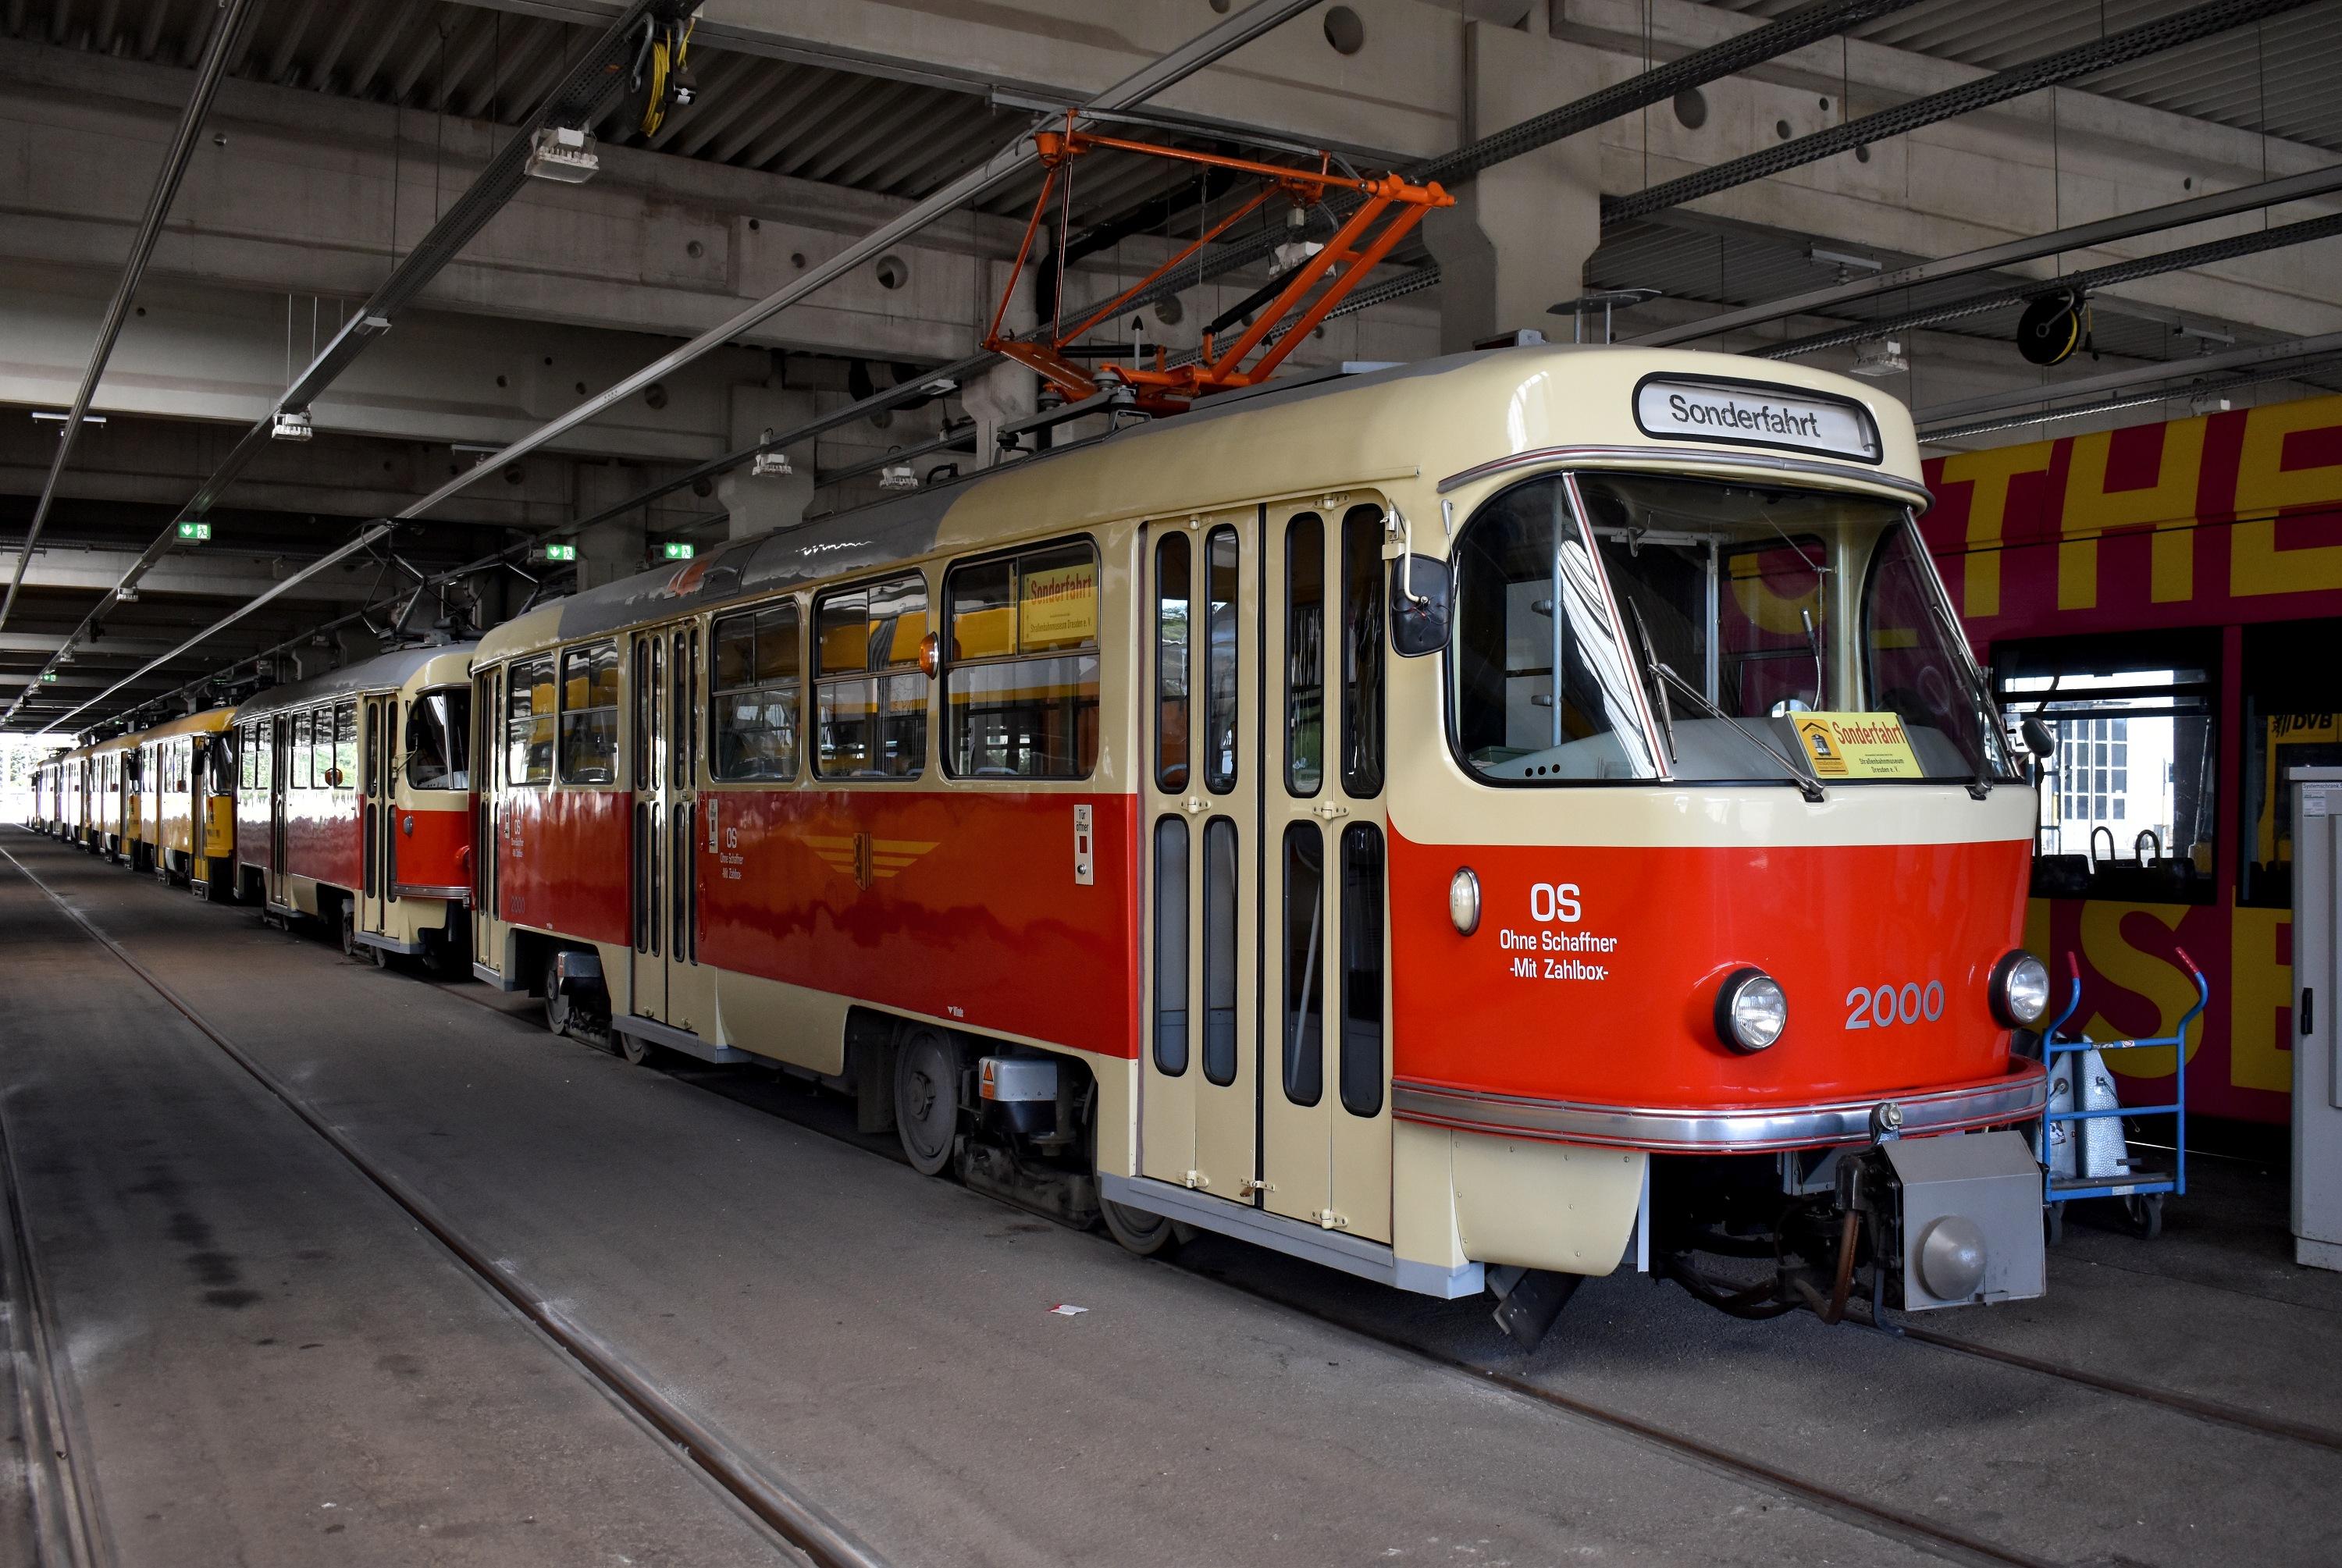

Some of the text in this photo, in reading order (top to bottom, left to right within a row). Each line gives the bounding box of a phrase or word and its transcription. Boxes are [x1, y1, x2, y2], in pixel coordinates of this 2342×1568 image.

[1669, 394, 1821, 439] Sonderfahrt
[1030, 573, 1092, 606] Sonderfahrt
[1068, 620, 1084, 629] Dresden
[1832, 720, 1906, 745] Sonderfahrt
[2292, 713, 2333, 730] DVB
[514, 820, 521, 835] OS
[727, 827, 737, 848] OS
[1076, 821, 1089, 832] öffner
[511, 896, 525, 913] 2000
[1530, 883, 1582, 923] OS
[1500, 929, 1618, 952] Ohne Schaffner
[1510, 957, 1609, 980] -Mit Zahlbox-
[1845, 980, 1945, 1029] 2000
